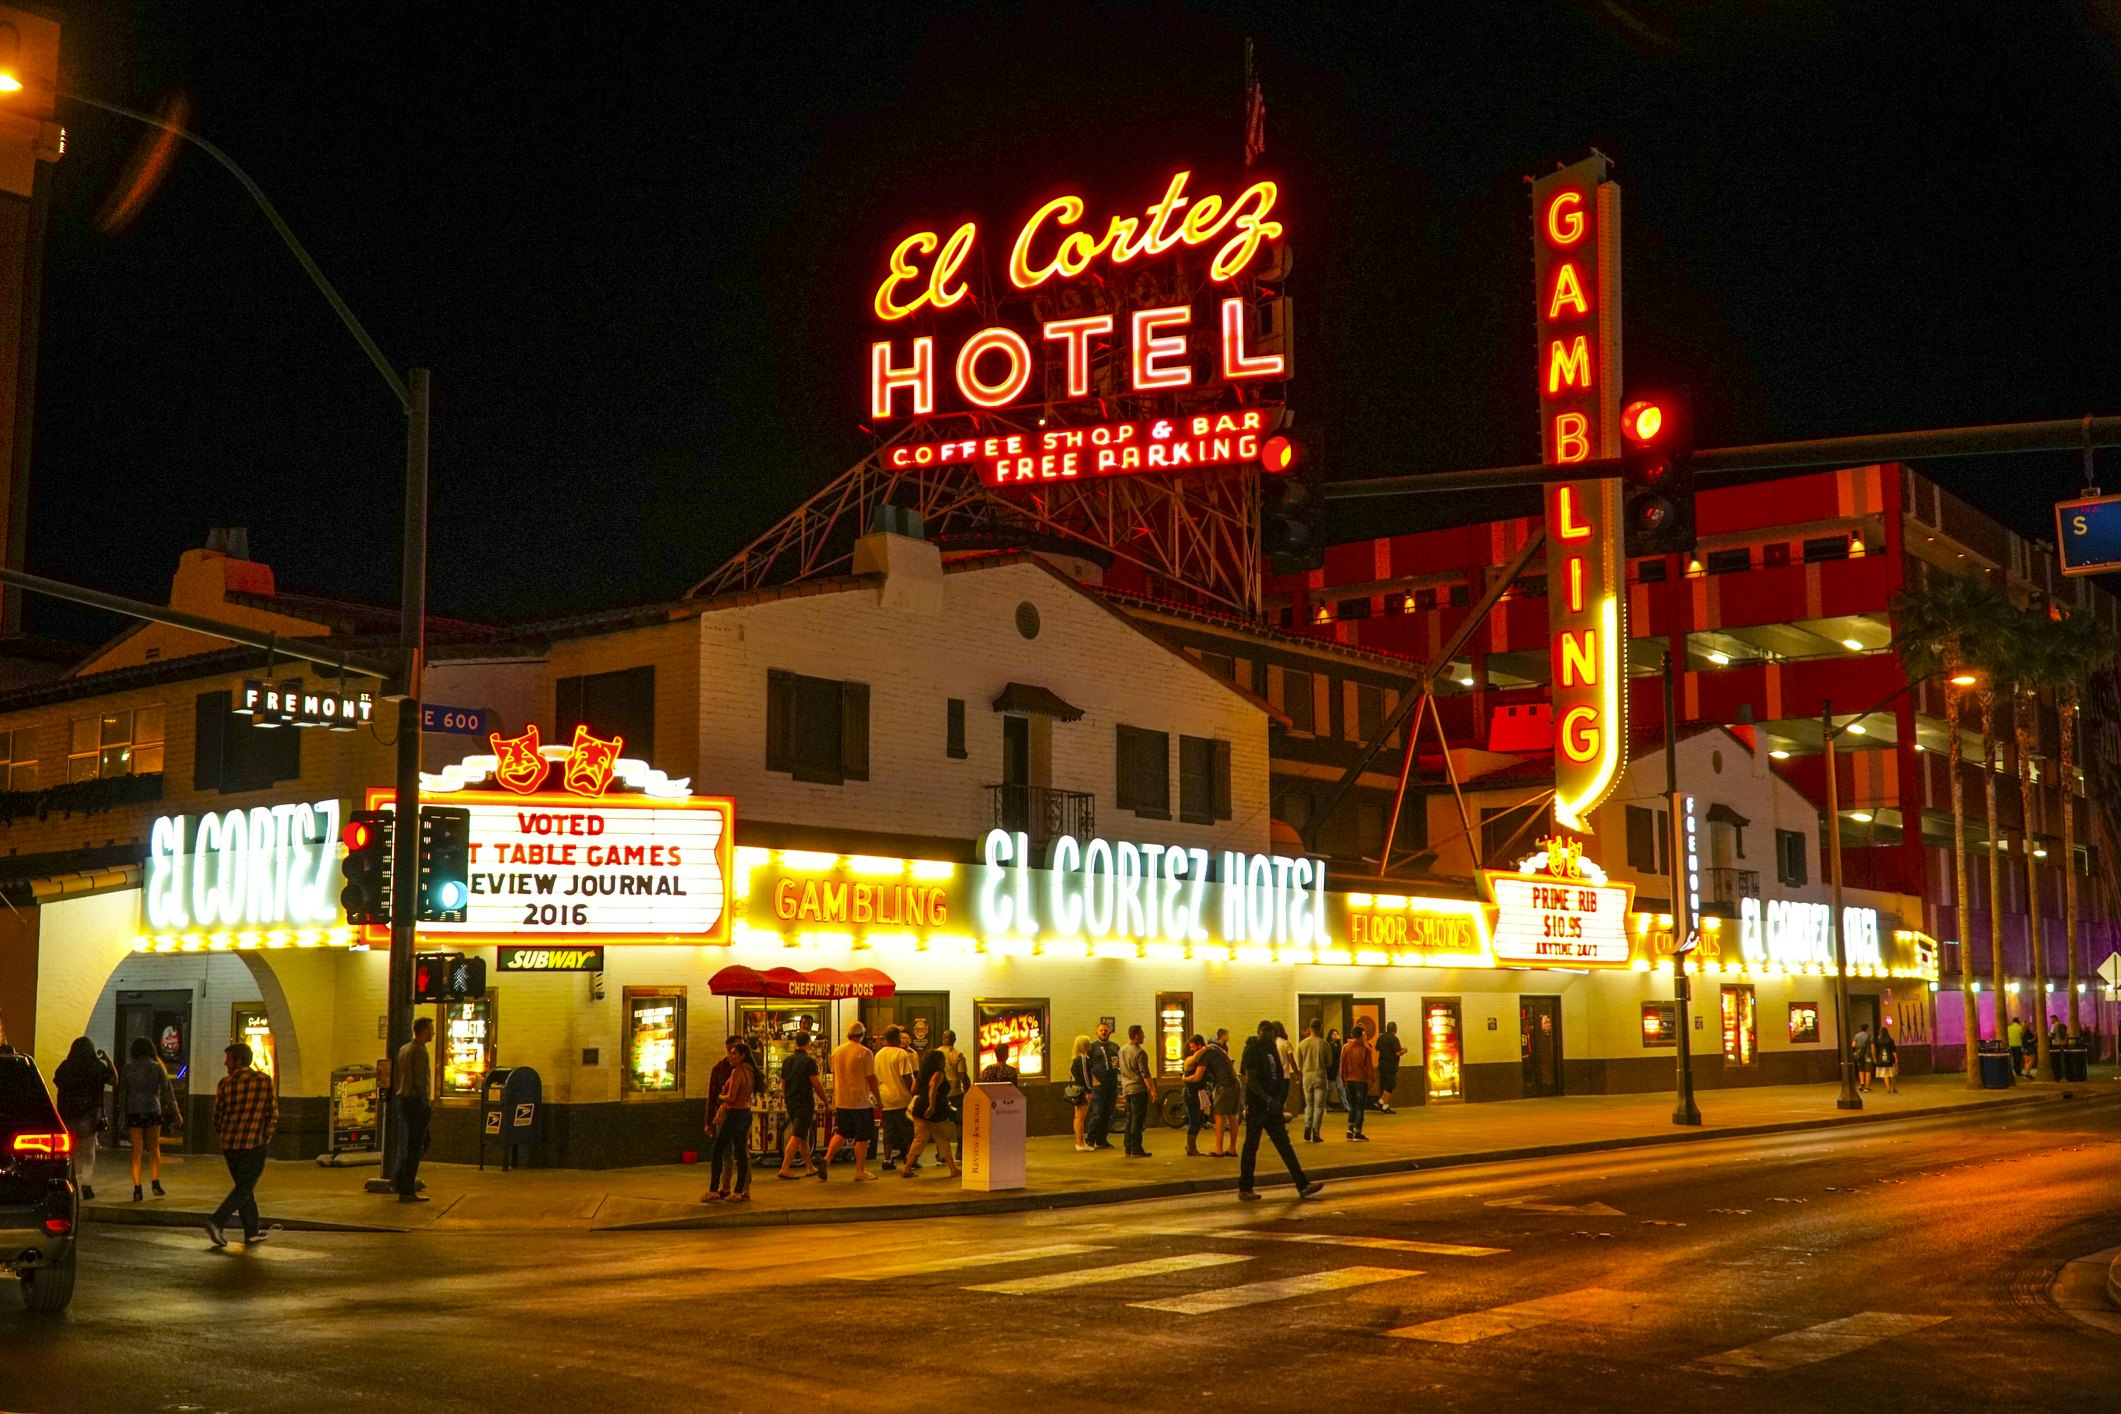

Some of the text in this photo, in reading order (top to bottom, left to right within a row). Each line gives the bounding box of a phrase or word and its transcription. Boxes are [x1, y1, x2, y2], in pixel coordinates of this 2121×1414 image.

[875, 171, 1283, 320] El Cortez
[872, 297, 1284, 419] HOTEL
[893, 412, 1260, 466] COFFEE SHOP & BAR
[996, 435, 1257, 482] FREE PARKING
[1548, 192, 1600, 763] GAMBLING
[246, 690, 372, 721] FREMONT
[424, 710, 479, 730] E 600
[517, 812, 605, 836] VOTED
[148, 799, 340, 927] EL CORTEZ
[494, 843, 577, 866] TABLE
[586, 845, 682, 867] GAMES
[470, 873, 687, 897] EVIEW JOURNAL
[982, 828, 1332, 945] EL CORTEZ HOTEL
[1532, 886, 1598, 913] PRIME RIB
[523, 904, 588, 925] 2016
[774, 877, 947, 927] GAMBLING
[1351, 913, 1471, 948] FLOOR SHOWS
[1544, 914, 1582, 938] $10.95
[507, 950, 596, 968] SUBWAY
[1536, 942, 1598, 957] ANYTIME 24/7
[788, 981, 874, 996] CHEFFINIS HOT DOGS
[980, 1014, 1039, 1049] 35% 43%
